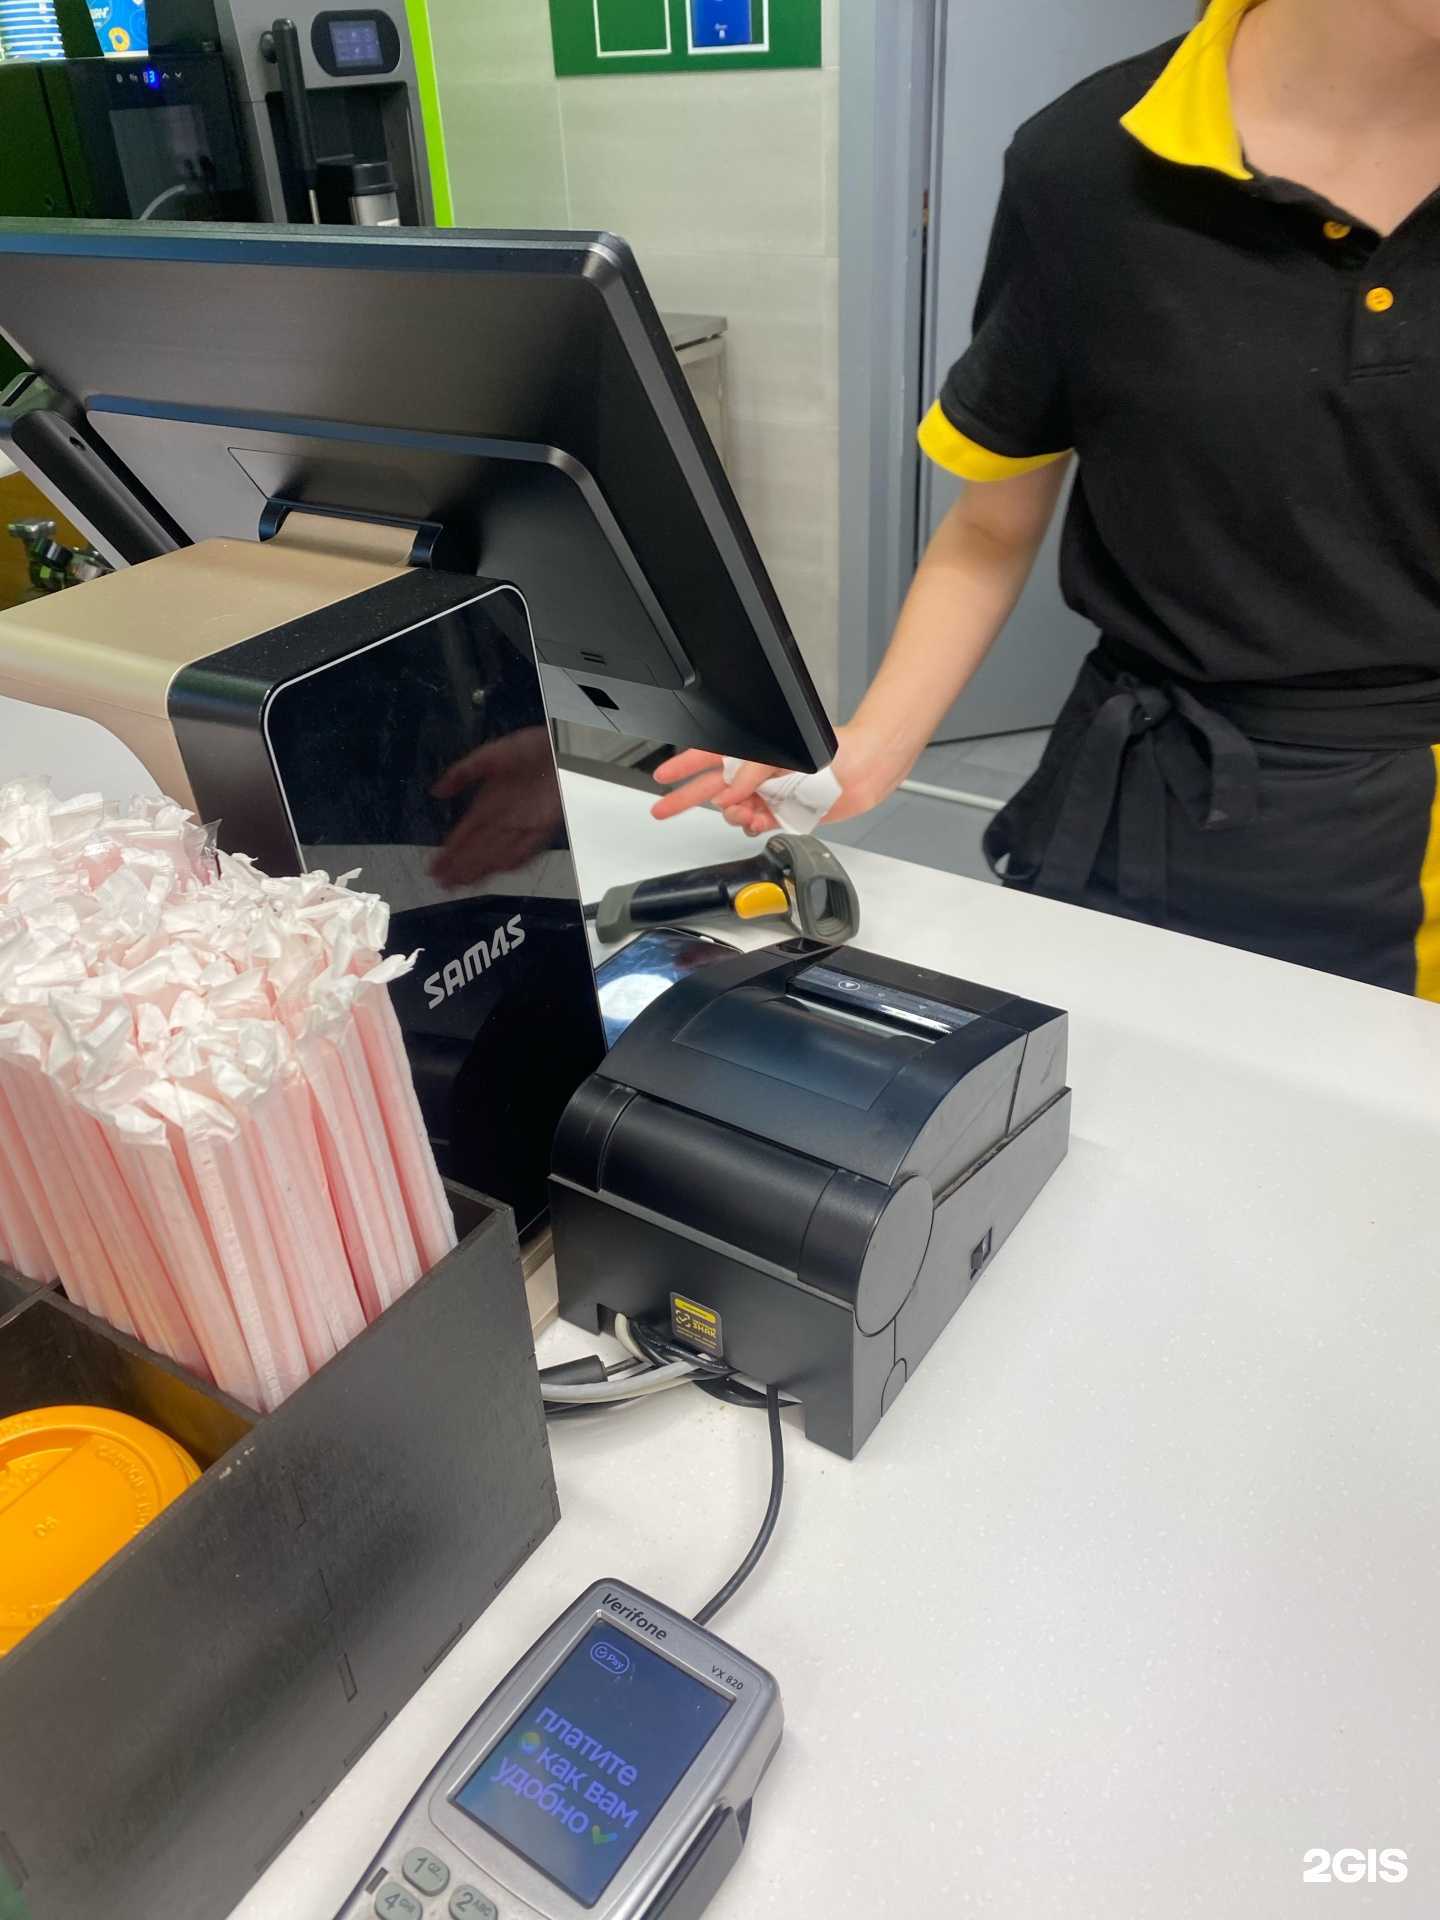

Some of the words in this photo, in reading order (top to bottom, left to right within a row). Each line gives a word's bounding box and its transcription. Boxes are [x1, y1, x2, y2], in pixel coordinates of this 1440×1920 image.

[602, 1593, 667, 1640] Verifone
[711, 1664, 723, 1679] VX
[726, 1675, 744, 1691] 820
[535, 1707, 638, 1786] платите
[490, 1758, 590, 1834] удобно
[536, 1747, 587, 1792] как
[584, 1780, 639, 1828] вам
[414, 1857, 428, 1873] 1
[385, 1893, 400, 1910] 4
[456, 1892, 473, 1912] 2
